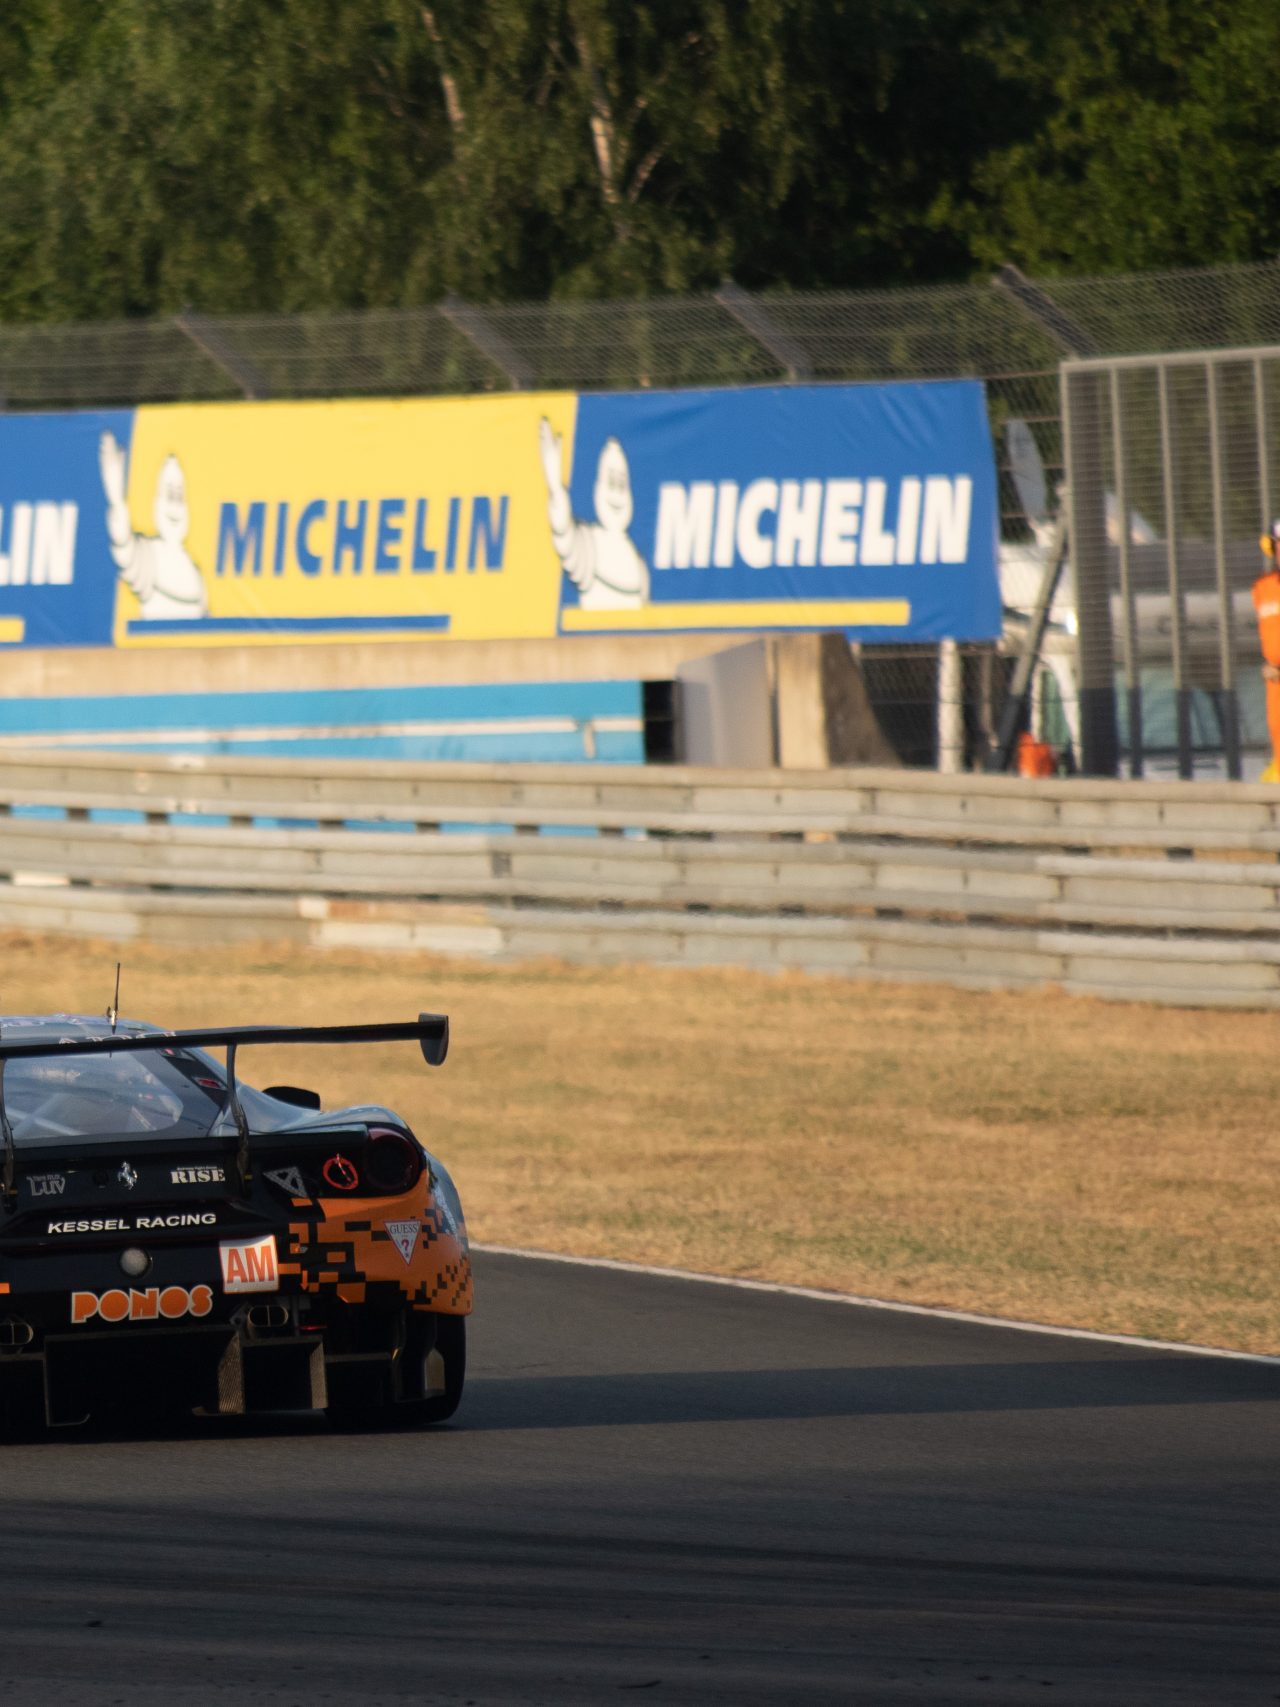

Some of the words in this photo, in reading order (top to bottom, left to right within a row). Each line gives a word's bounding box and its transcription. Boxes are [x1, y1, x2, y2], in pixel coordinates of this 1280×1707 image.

[217, 496, 508, 575] MICHELIN
[654, 476, 971, 569] MICHELIN
[170, 1168, 226, 1185] RISE
[47, 1219, 130, 1234] KESSEL
[136, 1212, 217, 1229] RACING
[389, 1223, 419, 1234] GUESS
[226, 1245, 275, 1284] AM
[71, 1284, 214, 1324] PONOS
